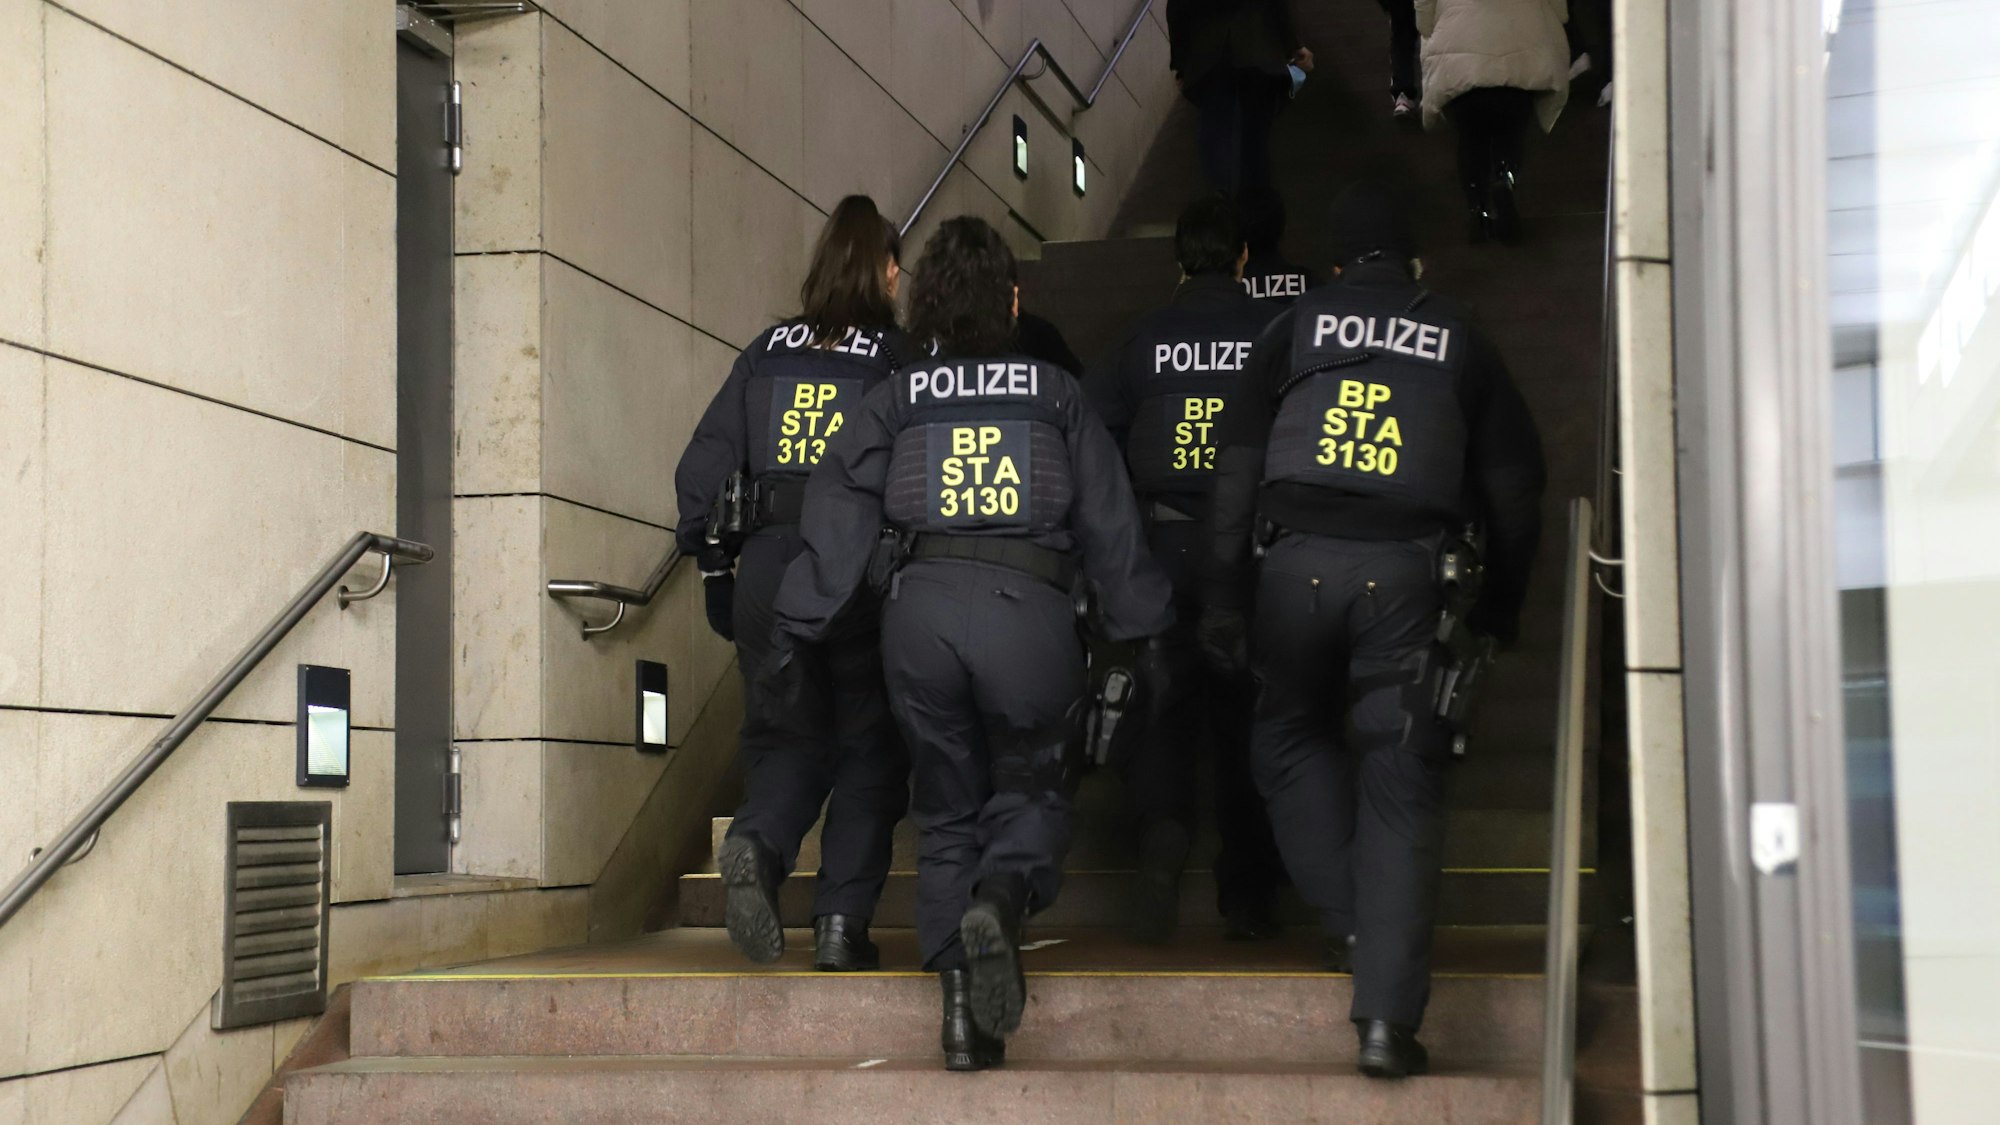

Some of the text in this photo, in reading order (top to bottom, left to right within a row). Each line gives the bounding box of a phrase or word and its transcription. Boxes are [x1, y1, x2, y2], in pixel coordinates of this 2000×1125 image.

[1242, 274, 1306, 298] LIZEI
[767, 323, 884, 358] POZEI
[1314, 314, 1449, 362] POLIZEI
[1155, 341, 1253, 374] POLIZE
[794, 383, 837, 409] BP
[910, 363, 1038, 404] POLIZEI
[1338, 379, 1391, 410] BP
[781, 410, 844, 437] STA
[1185, 398, 1224, 420] BP
[952, 426, 1002, 456] BP
[1175, 421, 1214, 445] ST
[1322, 407, 1403, 447] STA
[777, 438, 826, 465] 313
[1173, 446, 1217, 470] 313
[1316, 437, 1398, 476] 3130
[941, 456, 1021, 486] STA
[940, 486, 1019, 517] 3130
